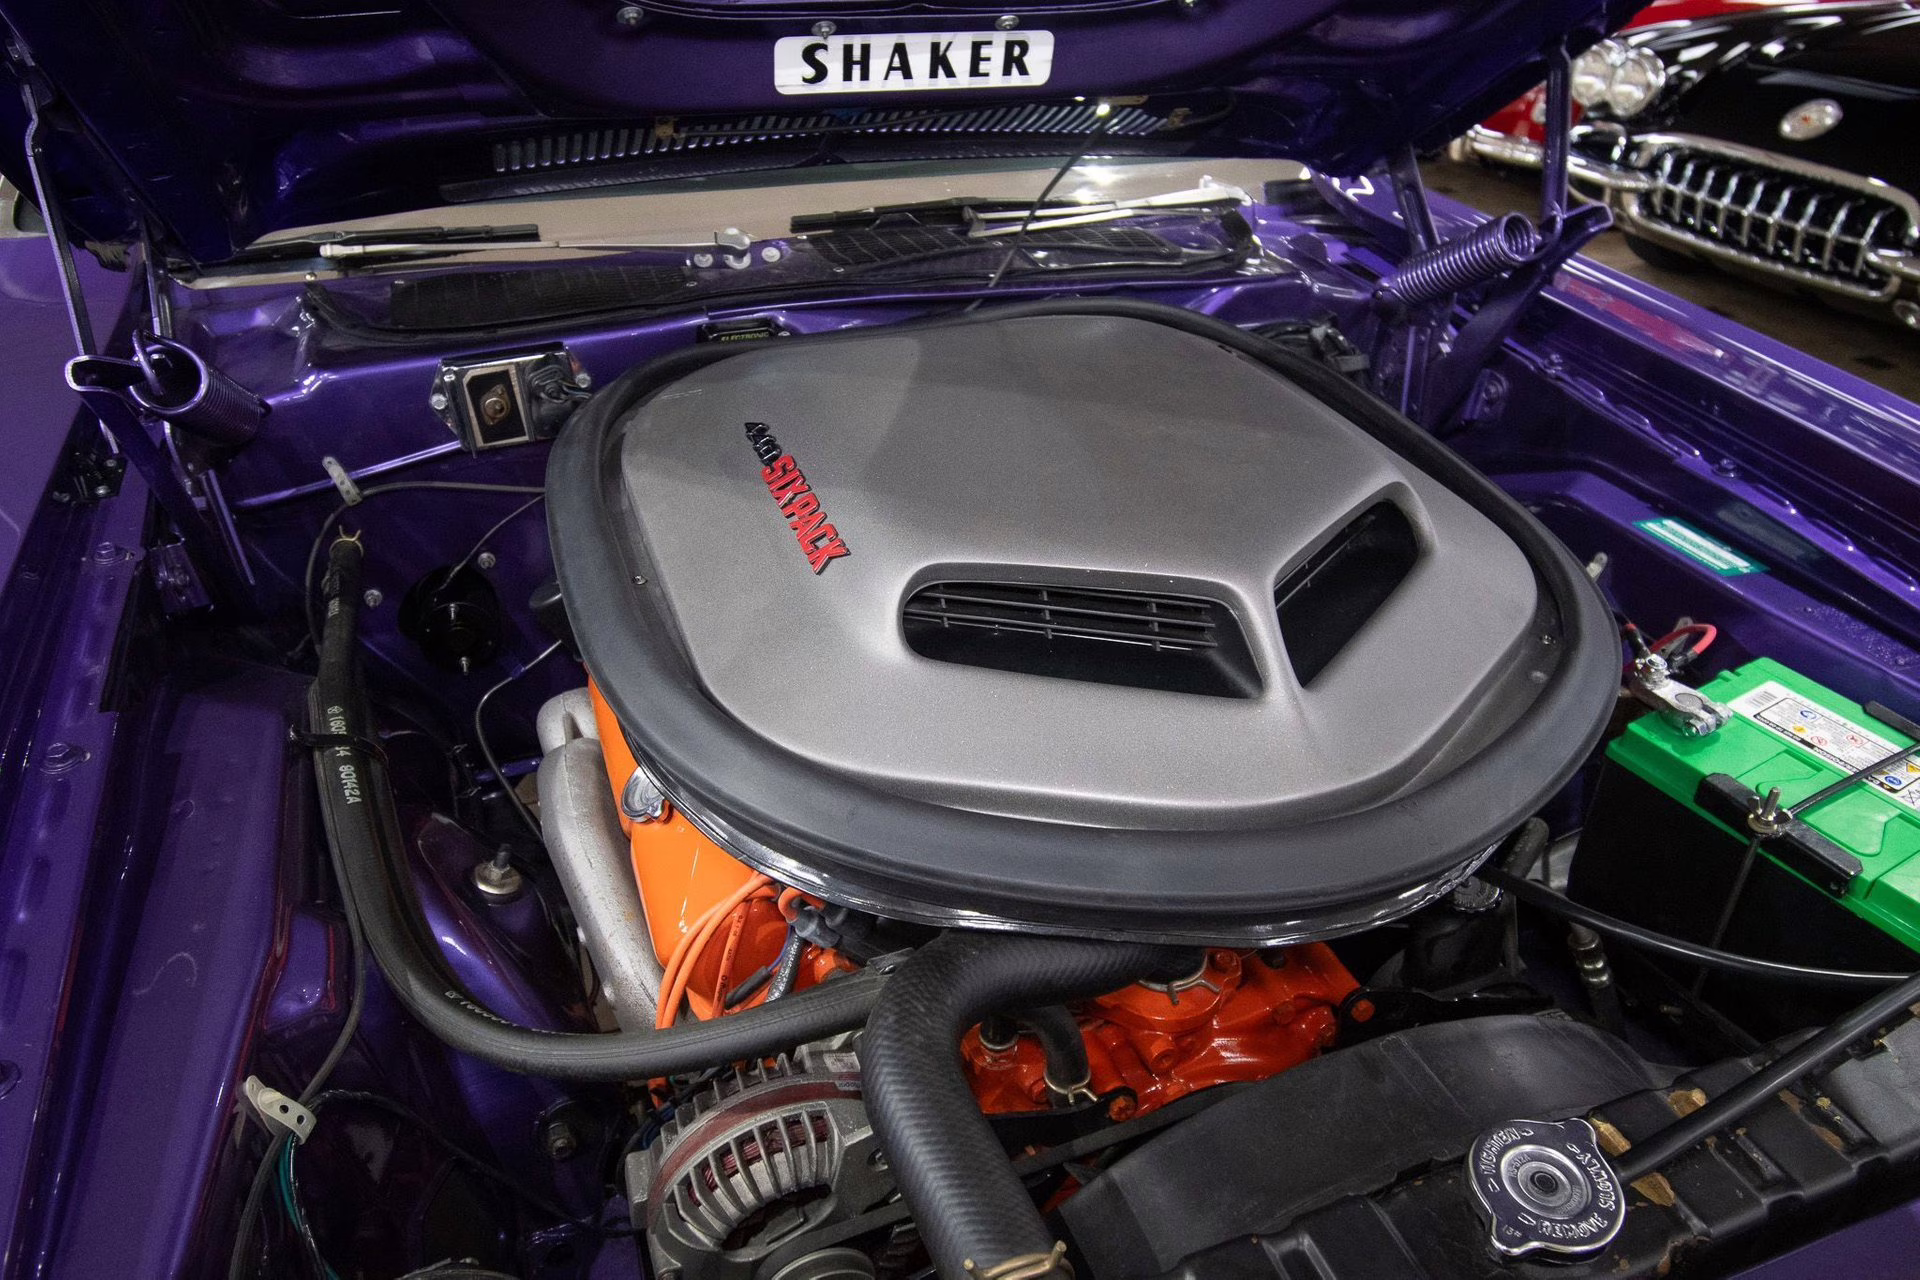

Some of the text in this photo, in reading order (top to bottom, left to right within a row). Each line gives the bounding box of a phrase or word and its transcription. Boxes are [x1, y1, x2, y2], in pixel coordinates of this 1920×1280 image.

[802, 39, 1030, 85] SHAKER
[744, 422, 782, 467] 440
[1480, 1128, 1521, 1174] TIGHTEN
[1538, 1213, 1607, 1239] REMOVE
[1577, 1153, 1615, 1211] SLOWLY
